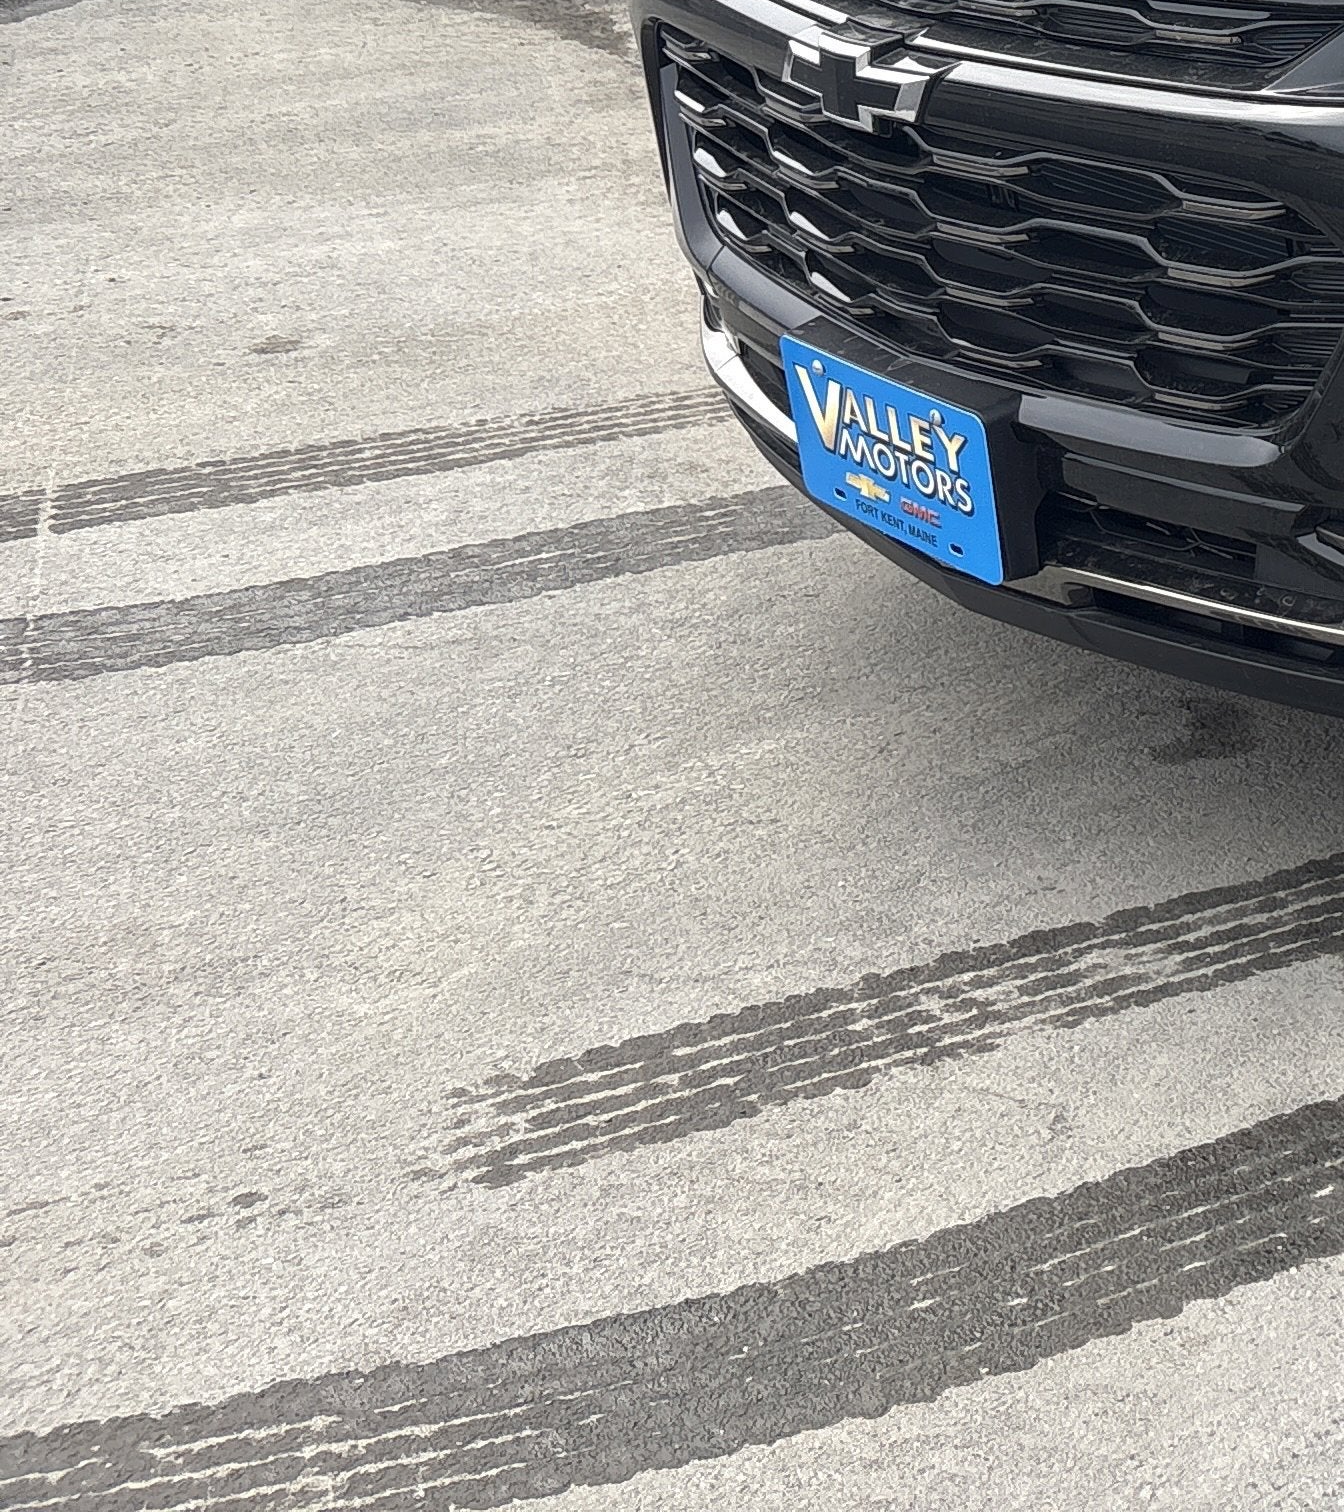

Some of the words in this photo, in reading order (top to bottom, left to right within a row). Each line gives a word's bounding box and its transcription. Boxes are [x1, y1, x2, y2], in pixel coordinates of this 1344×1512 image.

[792, 360, 968, 475] VALLEY
[838, 426, 974, 517] MOTORS
[855, 498, 879, 521] FORT
[880, 511, 908, 536] KENT,
[908, 523, 938, 548] MAINE
[900, 495, 943, 529] GMC
